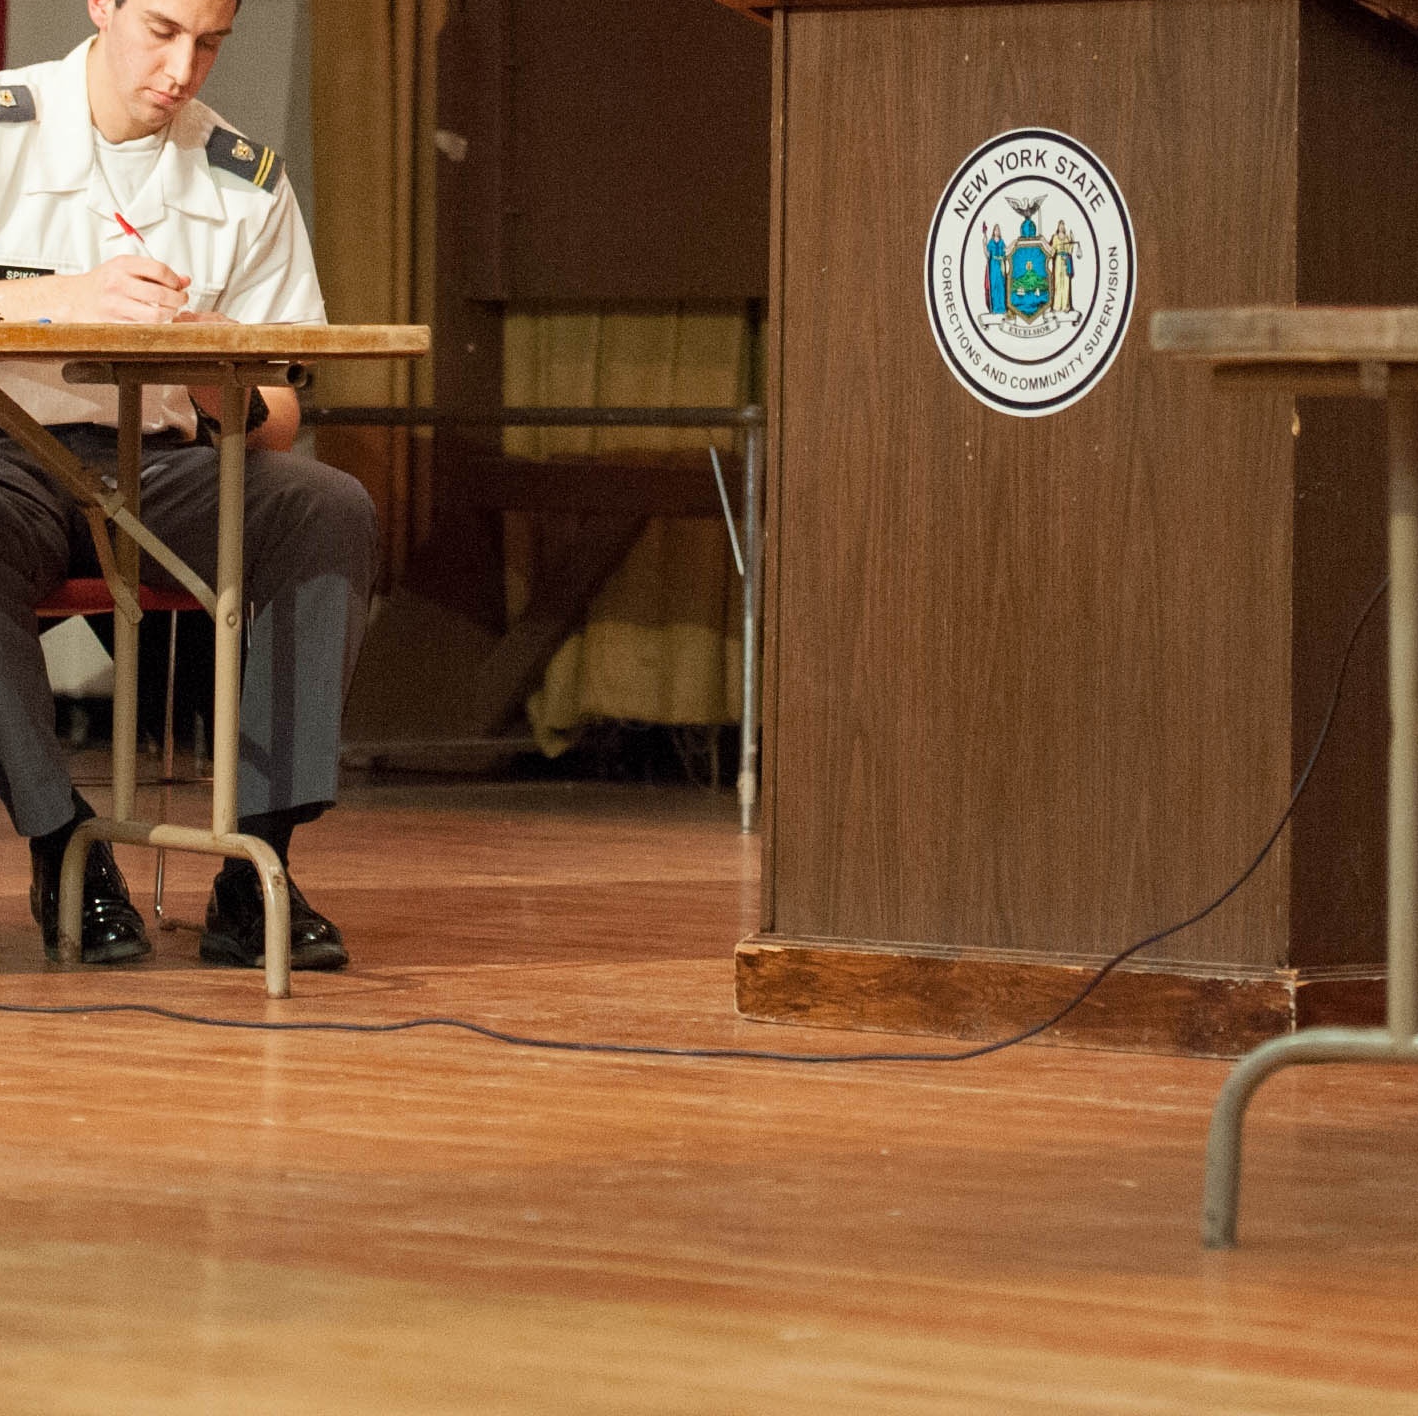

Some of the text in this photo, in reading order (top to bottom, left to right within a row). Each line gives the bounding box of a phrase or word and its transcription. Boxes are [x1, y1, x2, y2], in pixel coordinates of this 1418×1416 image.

[954, 148, 1106, 220] NEW YORK STATE
[941, 246, 1119, 391] CORRECTIONS AND COMMUNITY SUPERVISION
